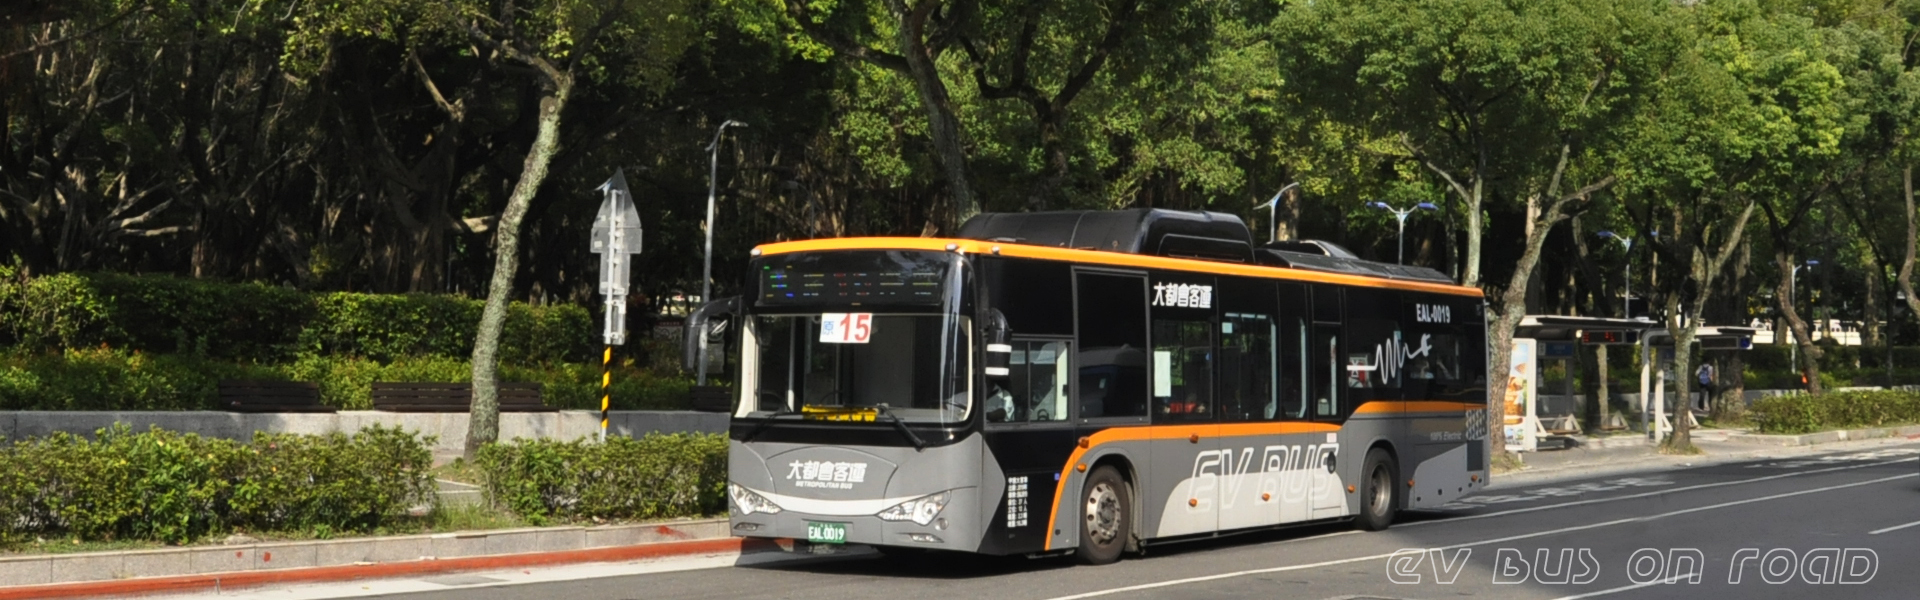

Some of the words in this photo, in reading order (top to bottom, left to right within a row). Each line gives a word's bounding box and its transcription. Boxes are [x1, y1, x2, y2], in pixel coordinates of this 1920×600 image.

[1152, 281, 1212, 309] 大都會客運
[1416, 303, 1451, 323] EAL-0019
[839, 313, 870, 342] 15
[786, 460, 868, 483] 大都會客運
[1186, 447, 1254, 512] EV
[1255, 443, 1339, 506] BUS
[808, 526, 845, 541] EAL-0019
